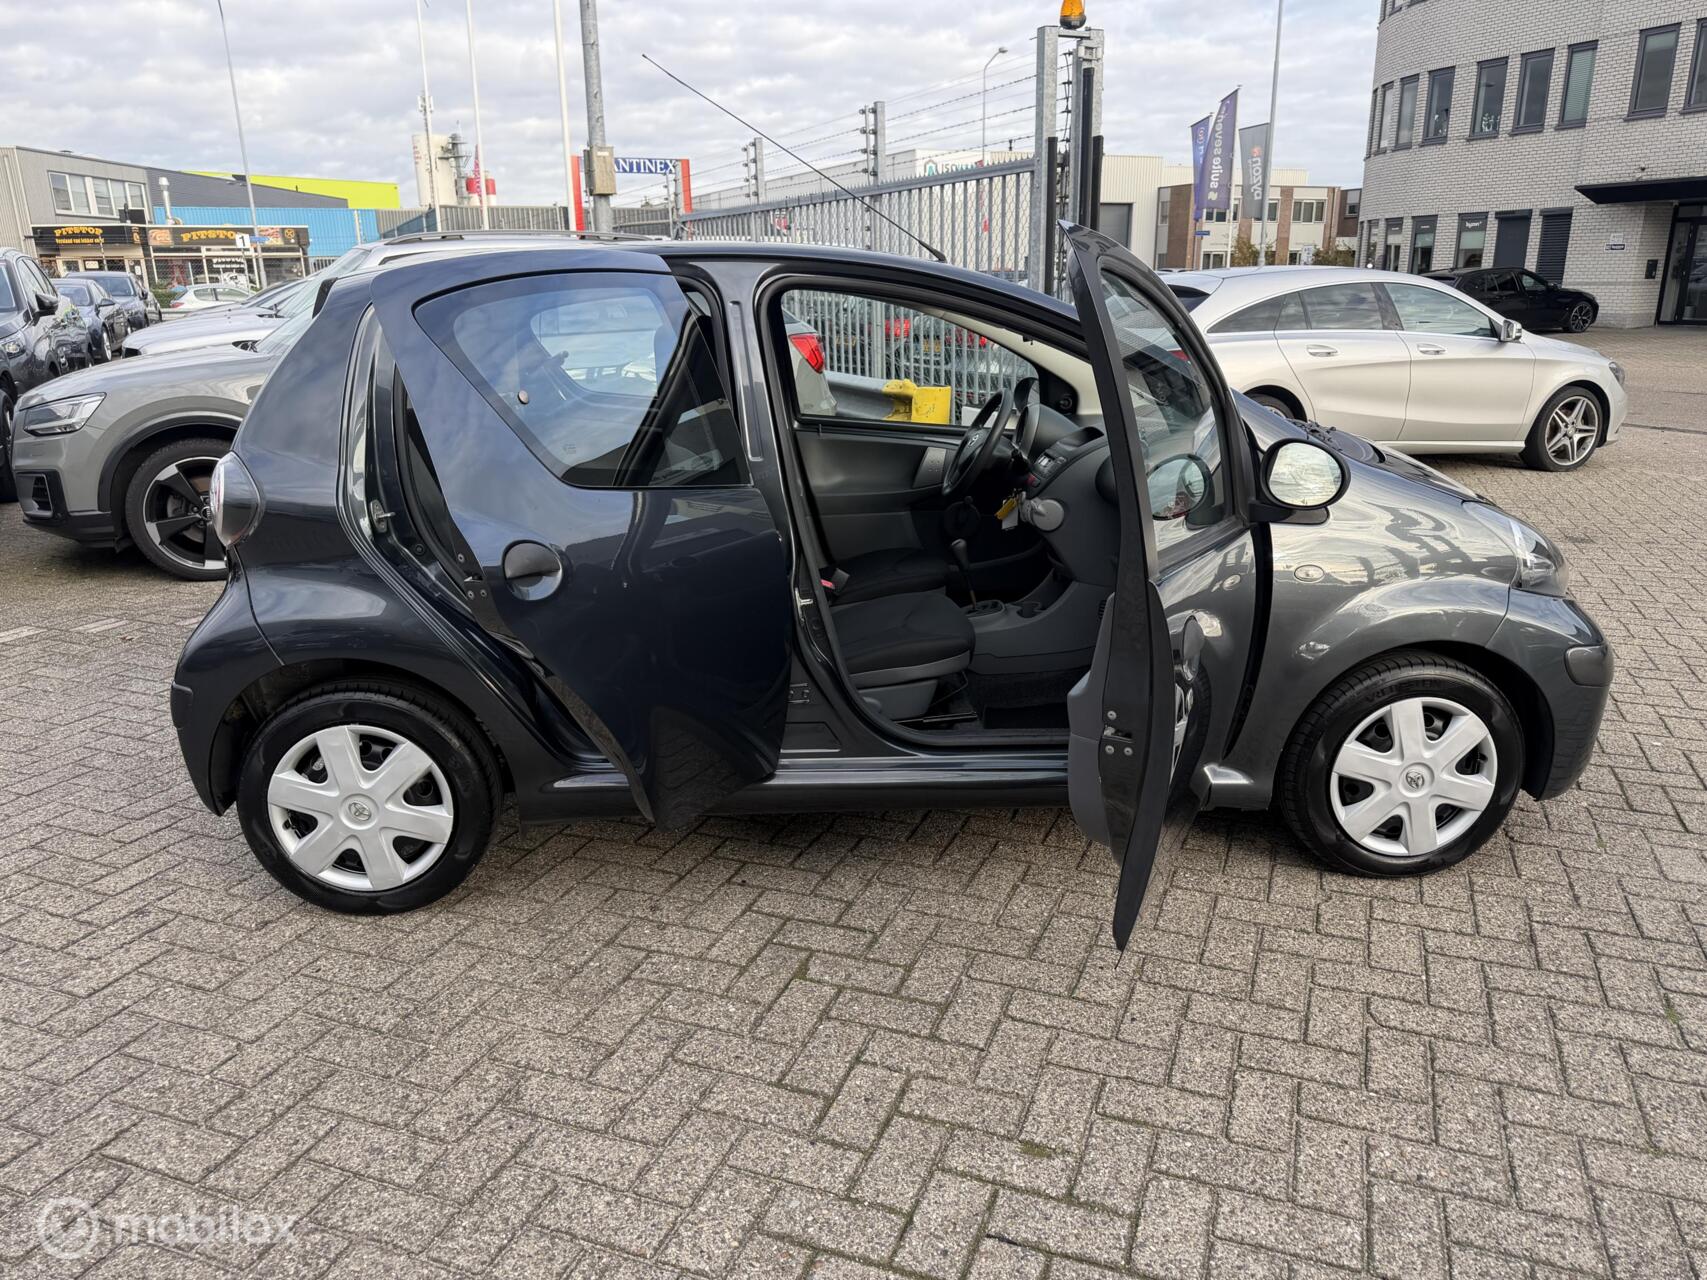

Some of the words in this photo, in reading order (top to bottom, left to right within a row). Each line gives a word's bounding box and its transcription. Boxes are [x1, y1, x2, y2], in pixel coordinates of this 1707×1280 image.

[54, 227, 104, 237] PITSTOP
[181, 229, 237, 242] PITSTO
[241, 235, 246, 247] 1
